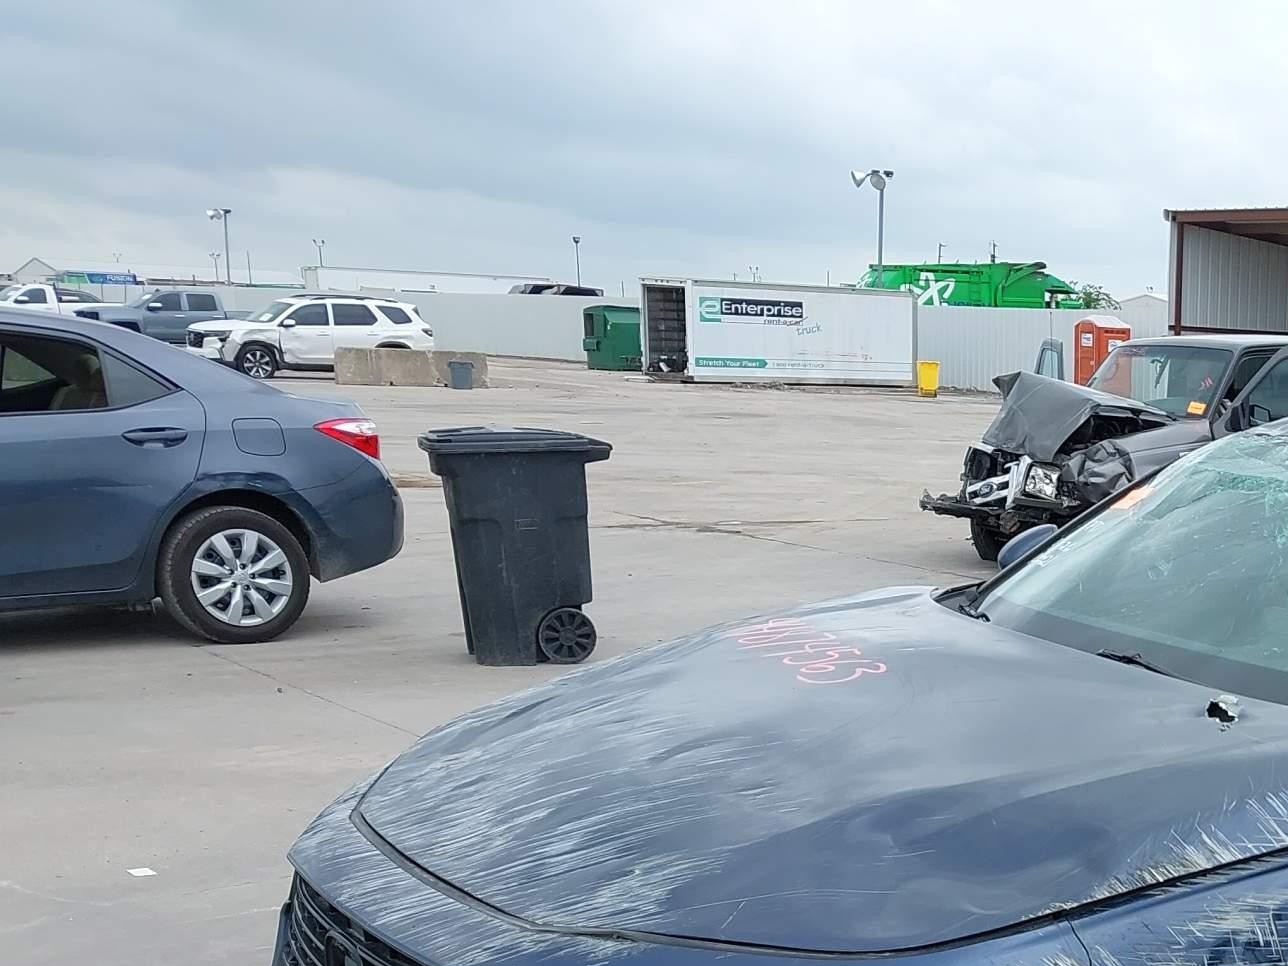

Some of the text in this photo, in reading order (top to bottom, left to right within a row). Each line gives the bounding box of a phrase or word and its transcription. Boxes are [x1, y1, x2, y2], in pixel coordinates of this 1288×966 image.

[722, 301, 802, 317] Enterprise
[797, 323, 821, 335] truck
[698, 359, 724, 367] Stretch
